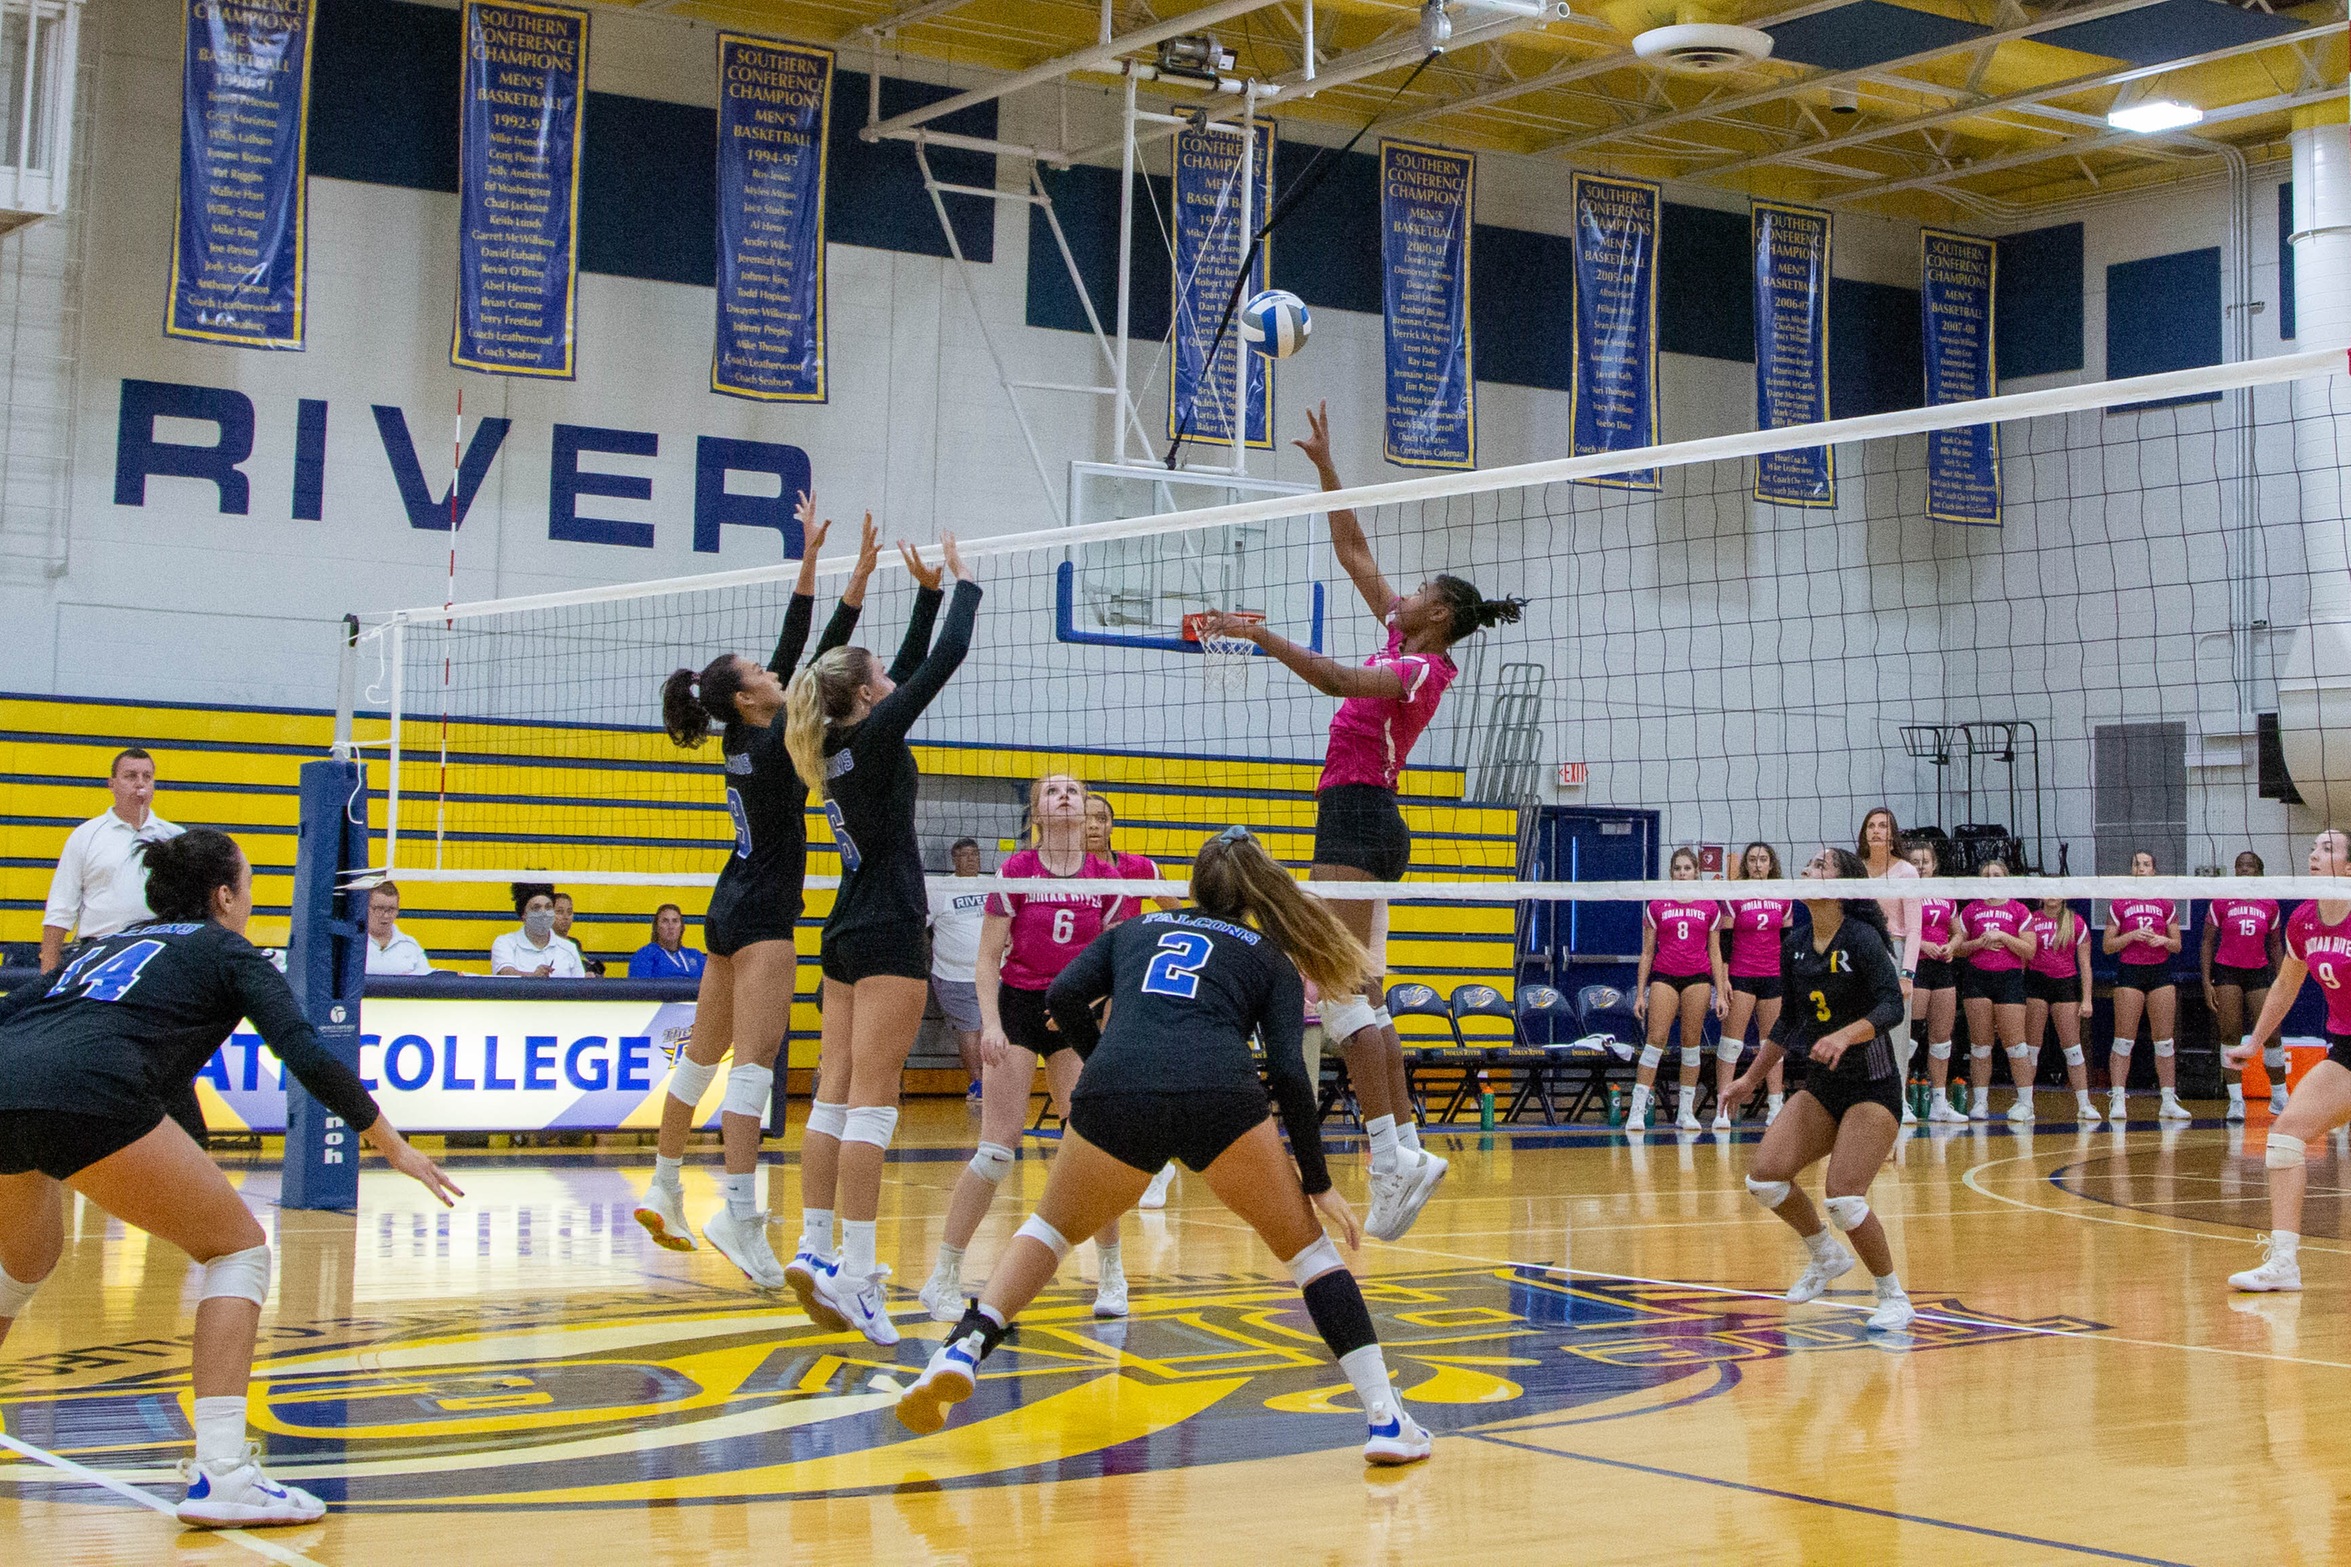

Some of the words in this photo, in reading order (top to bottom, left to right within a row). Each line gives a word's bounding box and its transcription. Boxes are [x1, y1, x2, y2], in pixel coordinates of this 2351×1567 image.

[480, 8, 567, 36] SOUTHERN
[471, 26, 575, 55] CONFERENCE
[473, 44, 573, 73] CHAMPIONS
[736, 48, 818, 75] SOUTHERN
[500, 73, 545, 90] MEN'S
[727, 65, 824, 94] CONFERENCE
[477, 88, 564, 110] BASKETBALL
[729, 83, 821, 110] CHAMPIONS
[755, 109, 797, 127] MEN'S
[733, 124, 811, 147] BASKETBALL
[747, 148, 799, 167] 1994-95
[1395, 152, 1461, 175] SOUTHERN
[1388, 167, 1466, 192] CONFERENCE
[1389, 184, 1463, 207] CHAMPIONS
[1585, 185, 1647, 205] SOUTHERN
[1410, 208, 1444, 222] MEN'S
[1580, 198, 1652, 221] CONFERENCE
[1394, 221, 1455, 240] BASKETBALL
[1581, 214, 1651, 235] CHAMPIONS
[480, 247, 509, 259] David
[1407, 241, 1447, 256] 2000-01
[1932, 242, 1985, 260] SOUTHERN
[1777, 263, 1806, 276] MEN'S
[1927, 268, 1987, 289] CHAMPIONS
[1945, 289, 1972, 303] MEN'S
[1941, 320, 1976, 334] 2007-08
[496, 331, 553, 345] Leatherwood
[477, 345, 504, 358] Coach
[114, 378, 811, 559] RIVER
[1564, 763, 1585, 783] EXIT
[1661, 908, 1684, 922] INDIAN
[1685, 908, 1706, 922] RIVER
[1929, 910, 1941, 928] 7
[1995, 910, 2013, 922] RIVER
[2124, 904, 2145, 917] INDIAN
[2146, 904, 2164, 917] RIVER
[2227, 906, 2248, 918] INDIAN
[2249, 907, 2266, 920] RIVER
[1052, 908, 1075, 944] 6
[1142, 912, 1261, 946] FALCONS
[1677, 921, 1689, 940] 8
[1756, 913, 1769, 930] 2
[2238, 919, 2256, 936] 15
[44, 938, 167, 1002] 14
[1141, 930, 1215, 999] 2
[1830, 950, 1853, 973] R
[2318, 962, 2341, 989] 9
[1809, 990, 1832, 1021] 3
[360, 1034, 651, 1092] COLLEGE
